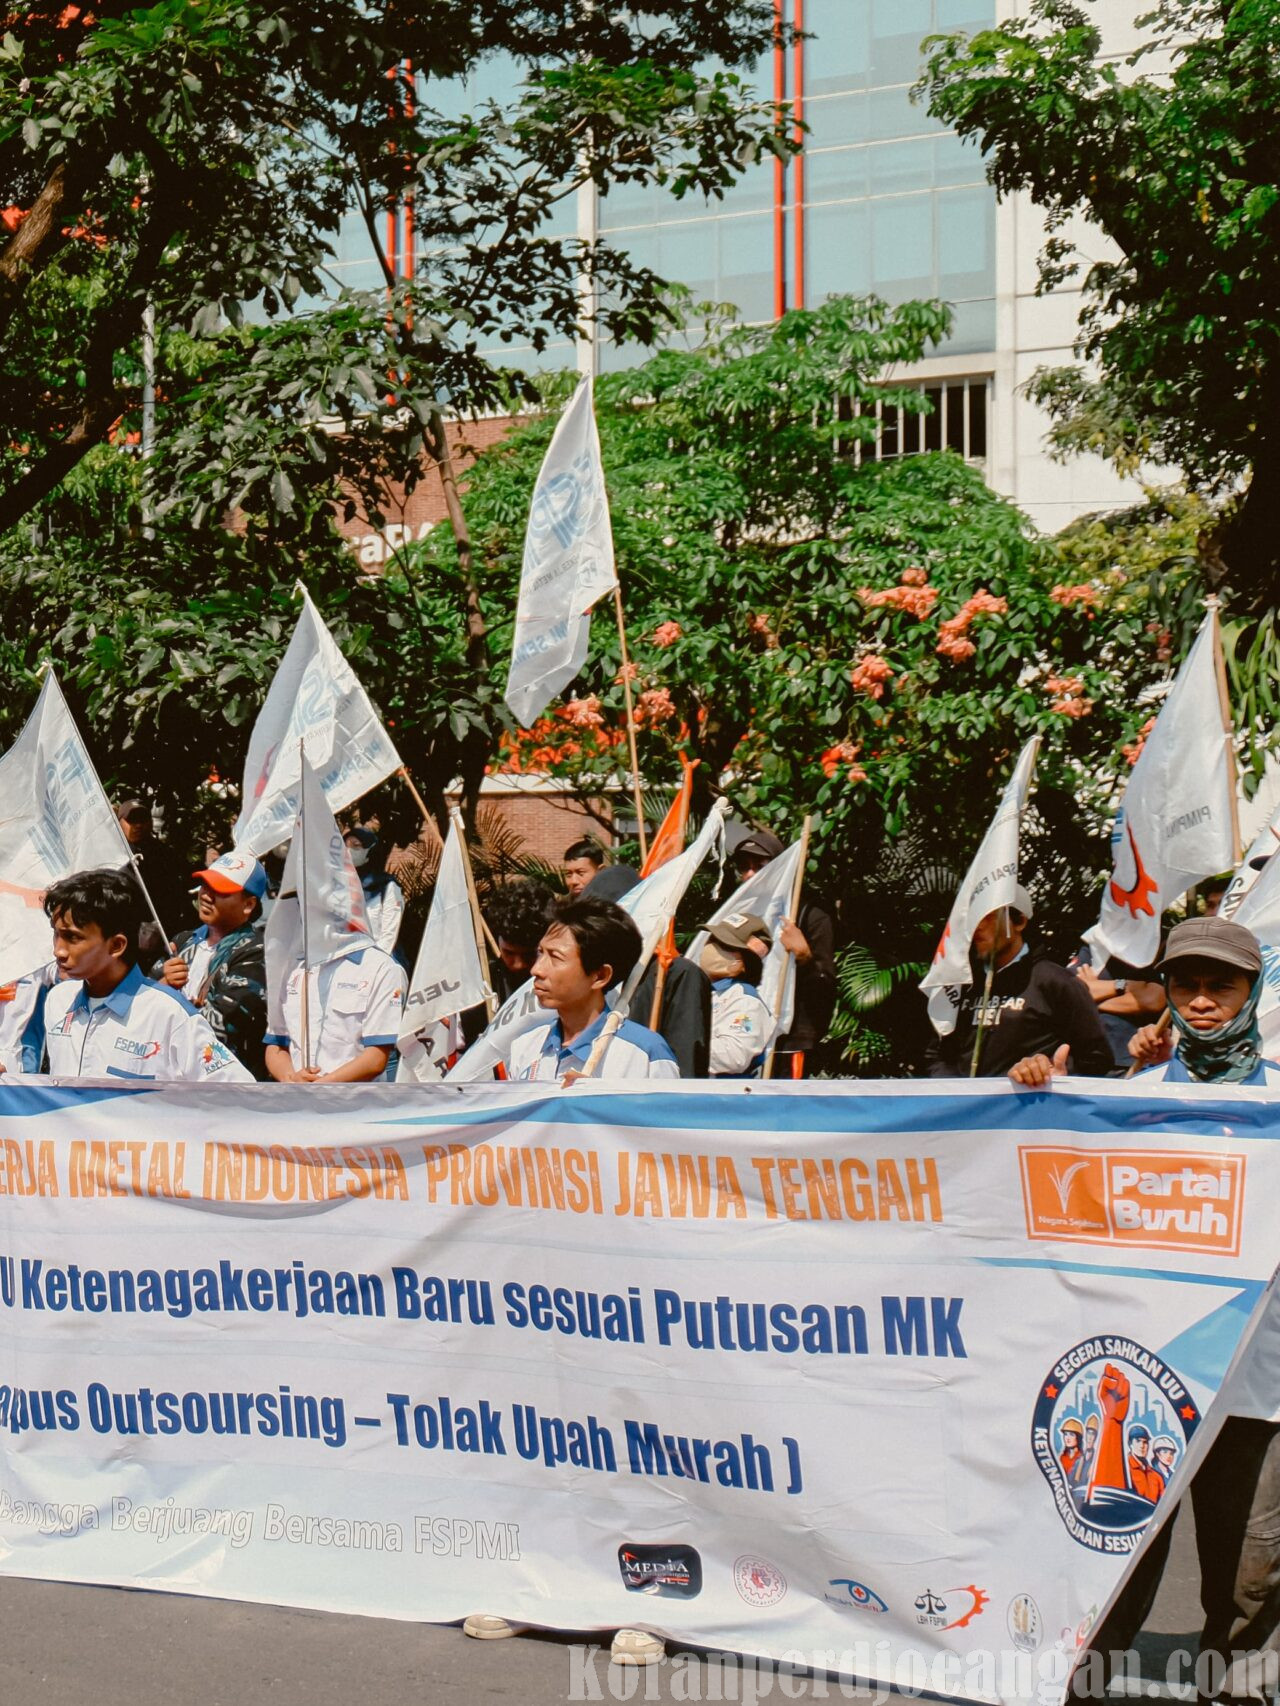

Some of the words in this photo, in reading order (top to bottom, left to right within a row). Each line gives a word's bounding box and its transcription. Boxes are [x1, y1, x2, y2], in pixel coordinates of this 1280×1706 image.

[114, 1036, 148, 1057] FSPMI
[68, 1140, 190, 1199] METAL
[202, 1141, 409, 1202] INDONESIA
[427, 1143, 603, 1215] PROVINSI
[614, 1151, 748, 1220] JAWA
[751, 1156, 943, 1223] TENGAH
[1112, 1165, 1231, 1200] Partai
[1113, 1199, 1228, 1236] Buruh
[20, 1260, 387, 1318] Ketenagakerjaan
[392, 1266, 496, 1326] Baru
[502, 1281, 645, 1344] sesuai
[654, 1288, 866, 1354] Putusan
[881, 1295, 968, 1359] MK
[1053, 1339, 1106, 1384] SEGERA
[1105, 1338, 1158, 1379] SAHKAN
[1160, 1367, 1186, 1401] UU
[87, 1382, 347, 1448] Outsoursing
[386, 1393, 507, 1456] Tolak
[513, 1405, 619, 1473] Upah
[628, 1416, 775, 1493] Murah
[111, 1496, 254, 1549] Berjuang
[264, 1503, 403, 1552] Bersama
[414, 1515, 522, 1562] FSPMI
